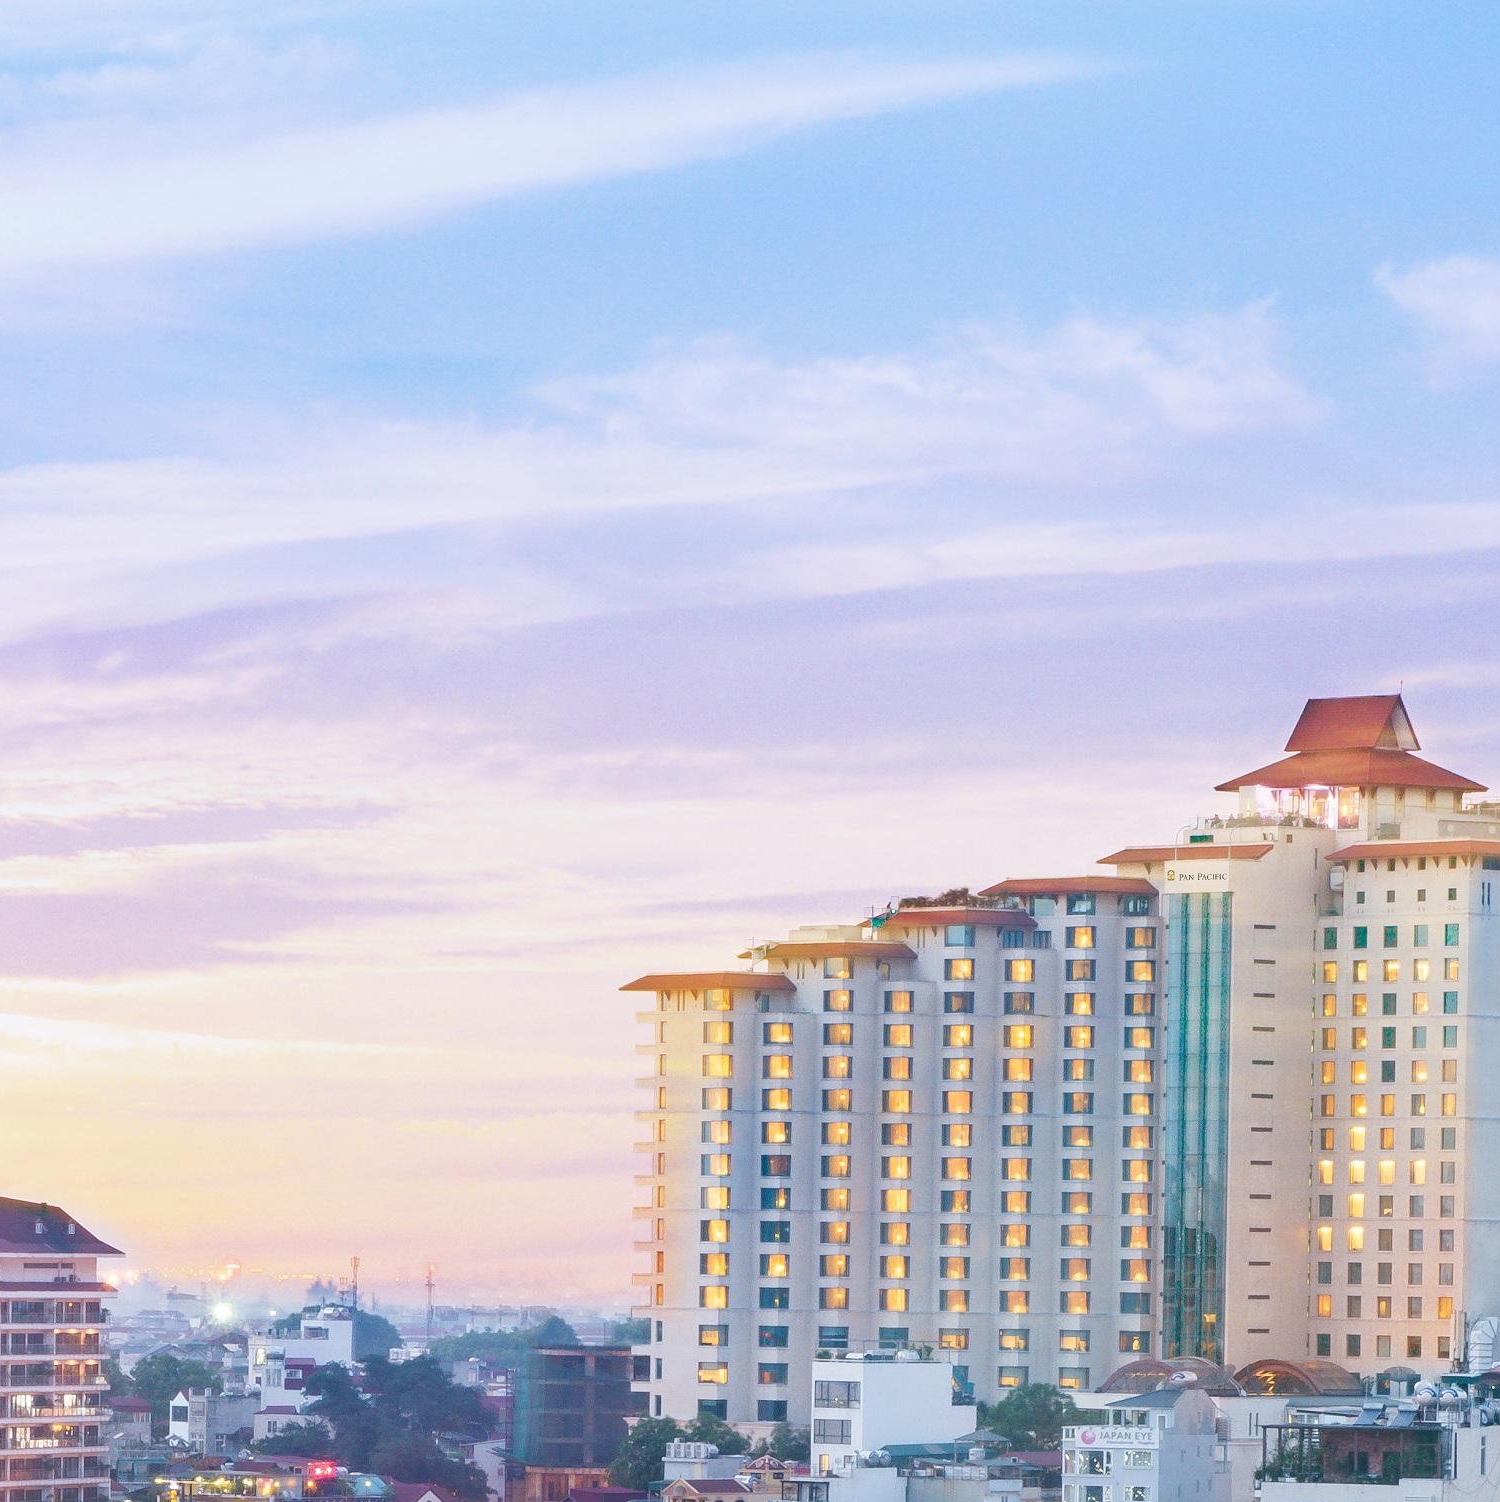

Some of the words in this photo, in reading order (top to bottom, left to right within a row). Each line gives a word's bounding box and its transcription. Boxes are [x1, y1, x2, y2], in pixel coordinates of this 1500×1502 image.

[1179, 873, 1194, 881] PAN
[1197, 873, 1228, 881] PACIFIC
[1100, 1431, 1131, 1440] JAPAN
[1135, 1432, 1153, 1441] EYE
